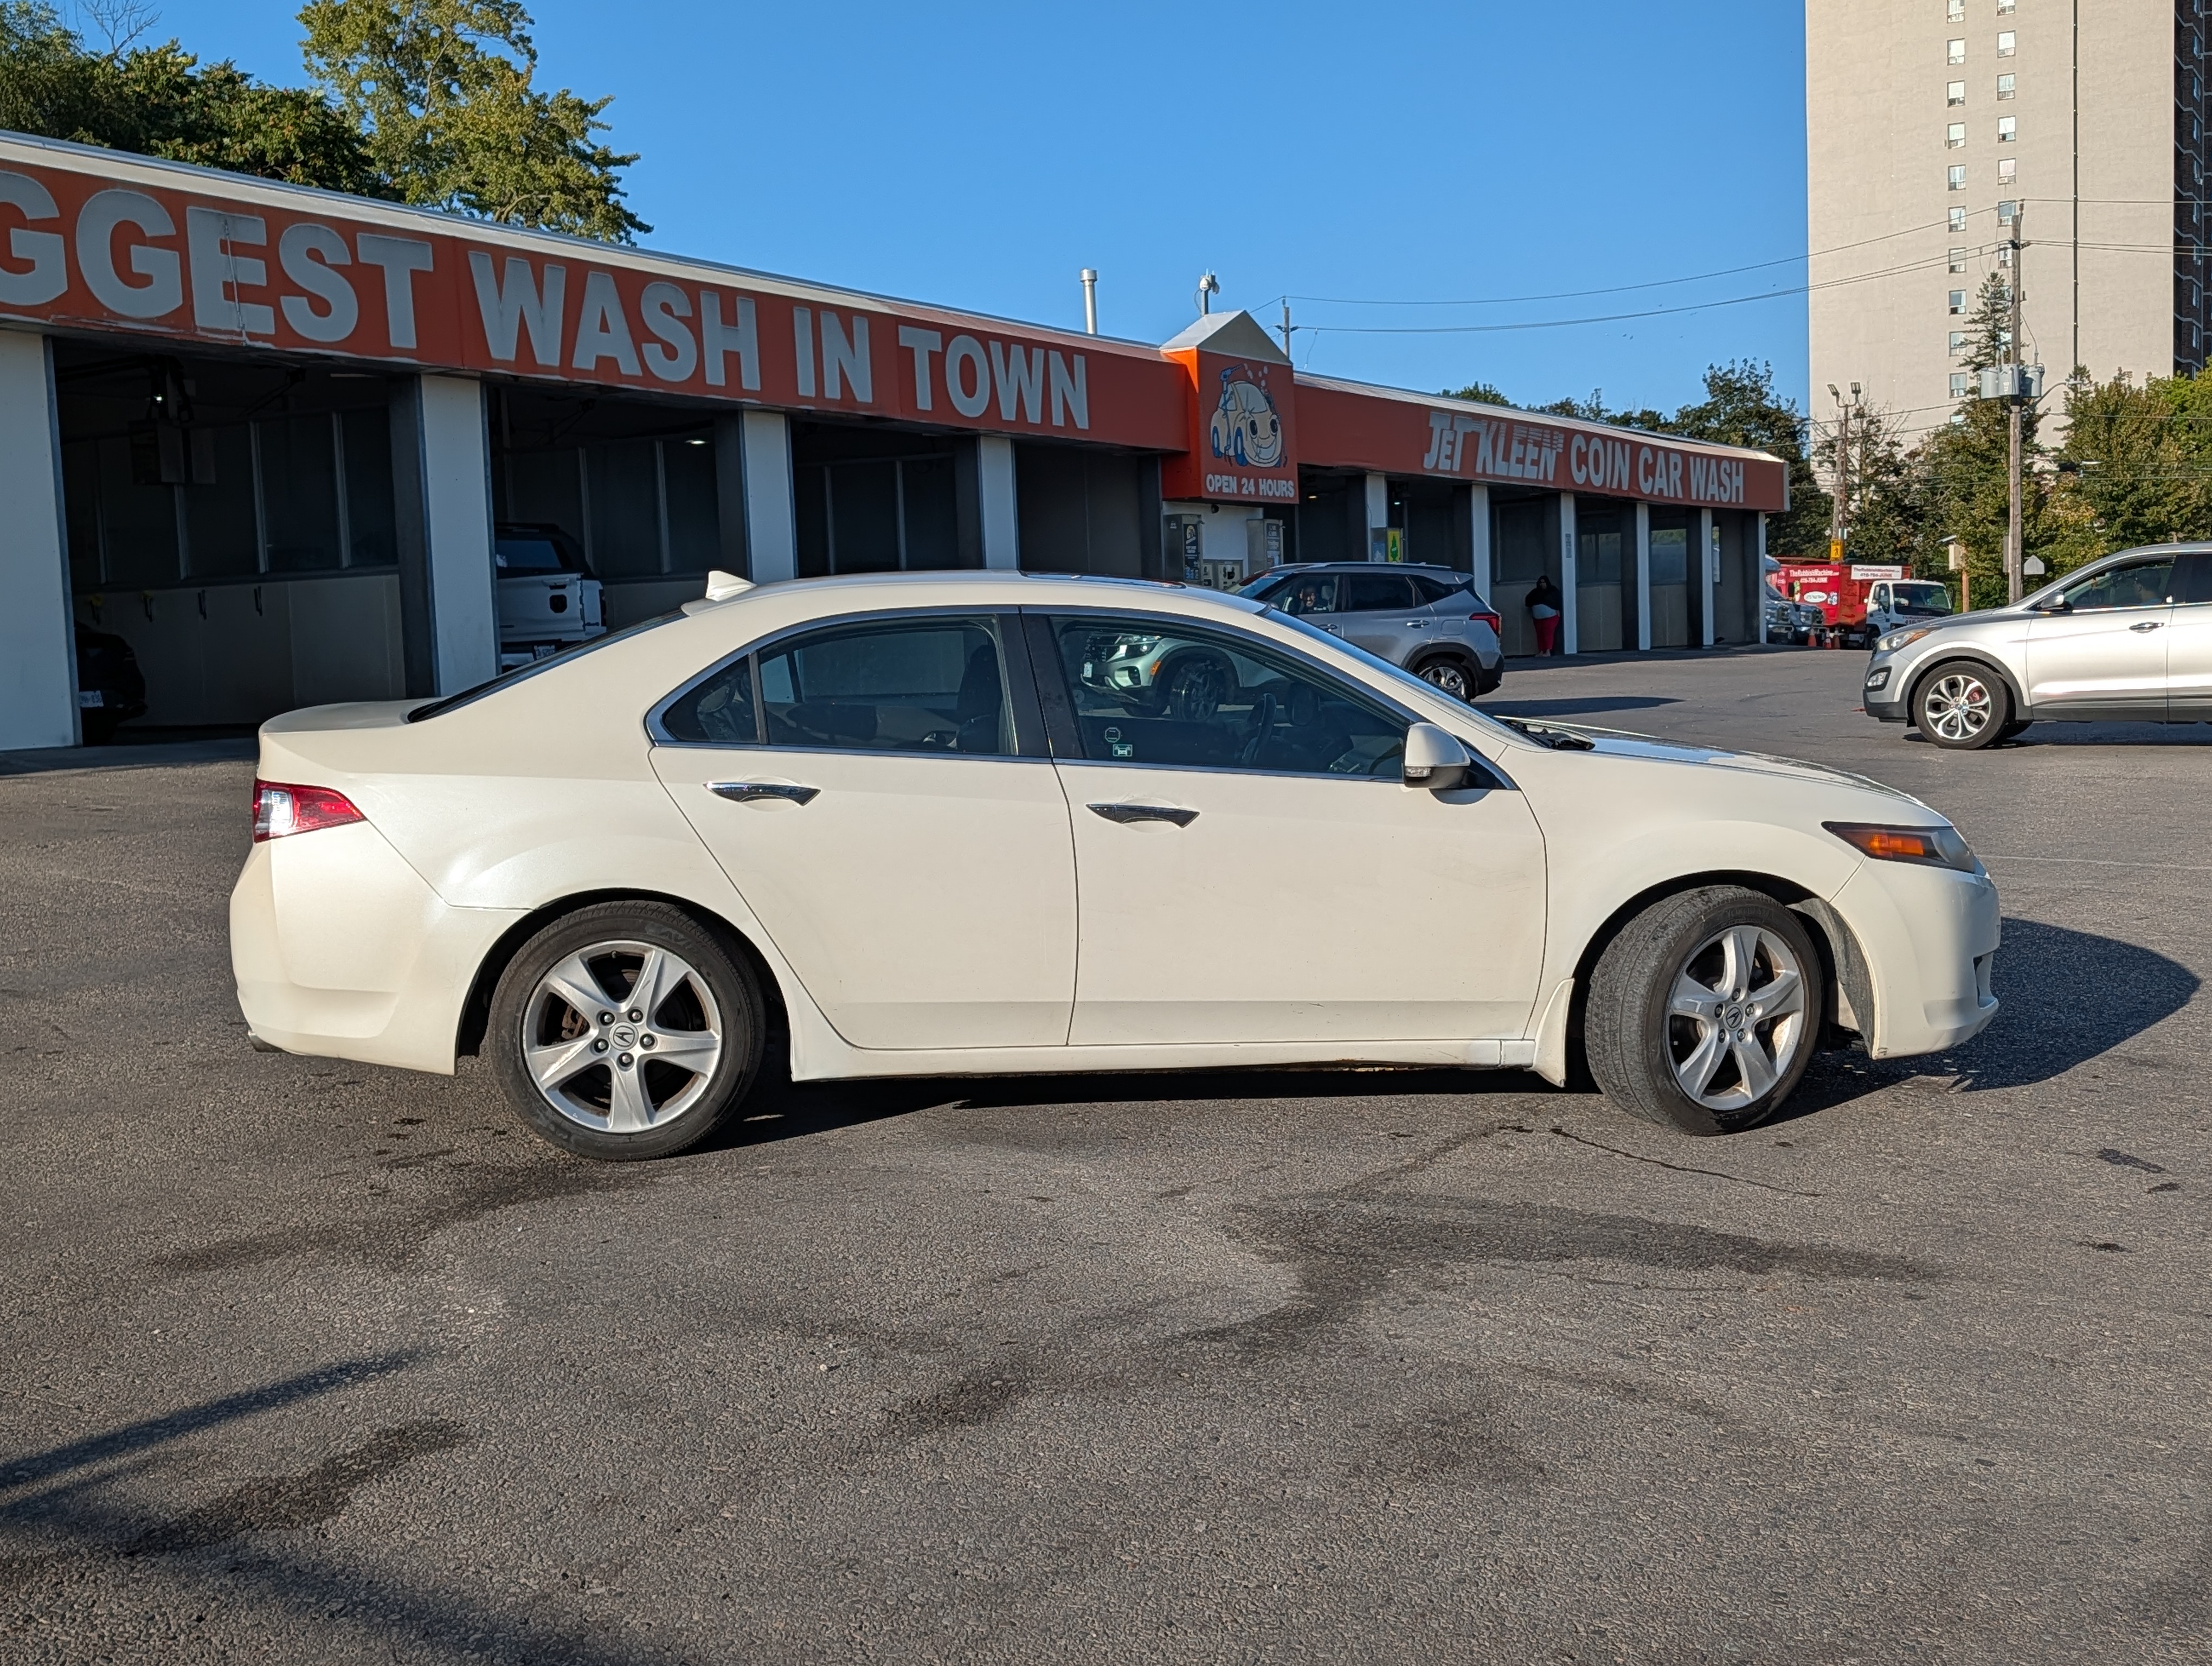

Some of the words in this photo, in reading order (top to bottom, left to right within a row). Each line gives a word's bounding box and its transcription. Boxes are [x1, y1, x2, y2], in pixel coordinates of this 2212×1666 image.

[468, 250, 761, 392] WASH
[793, 306, 873, 403] IN
[898, 325, 1089, 430] TOWN
[1206, 473, 1237, 494] OPEN
[1241, 477, 1255, 495] 24
[1258, 478, 1295, 498] HOURS
[1423, 412, 1477, 471] JET
[1476, 420, 1565, 481] KLEEN
[1570, 434, 1630, 491] COIN
[1638, 446, 1683, 499] CAR
[1689, 456, 1744, 503] WASH
